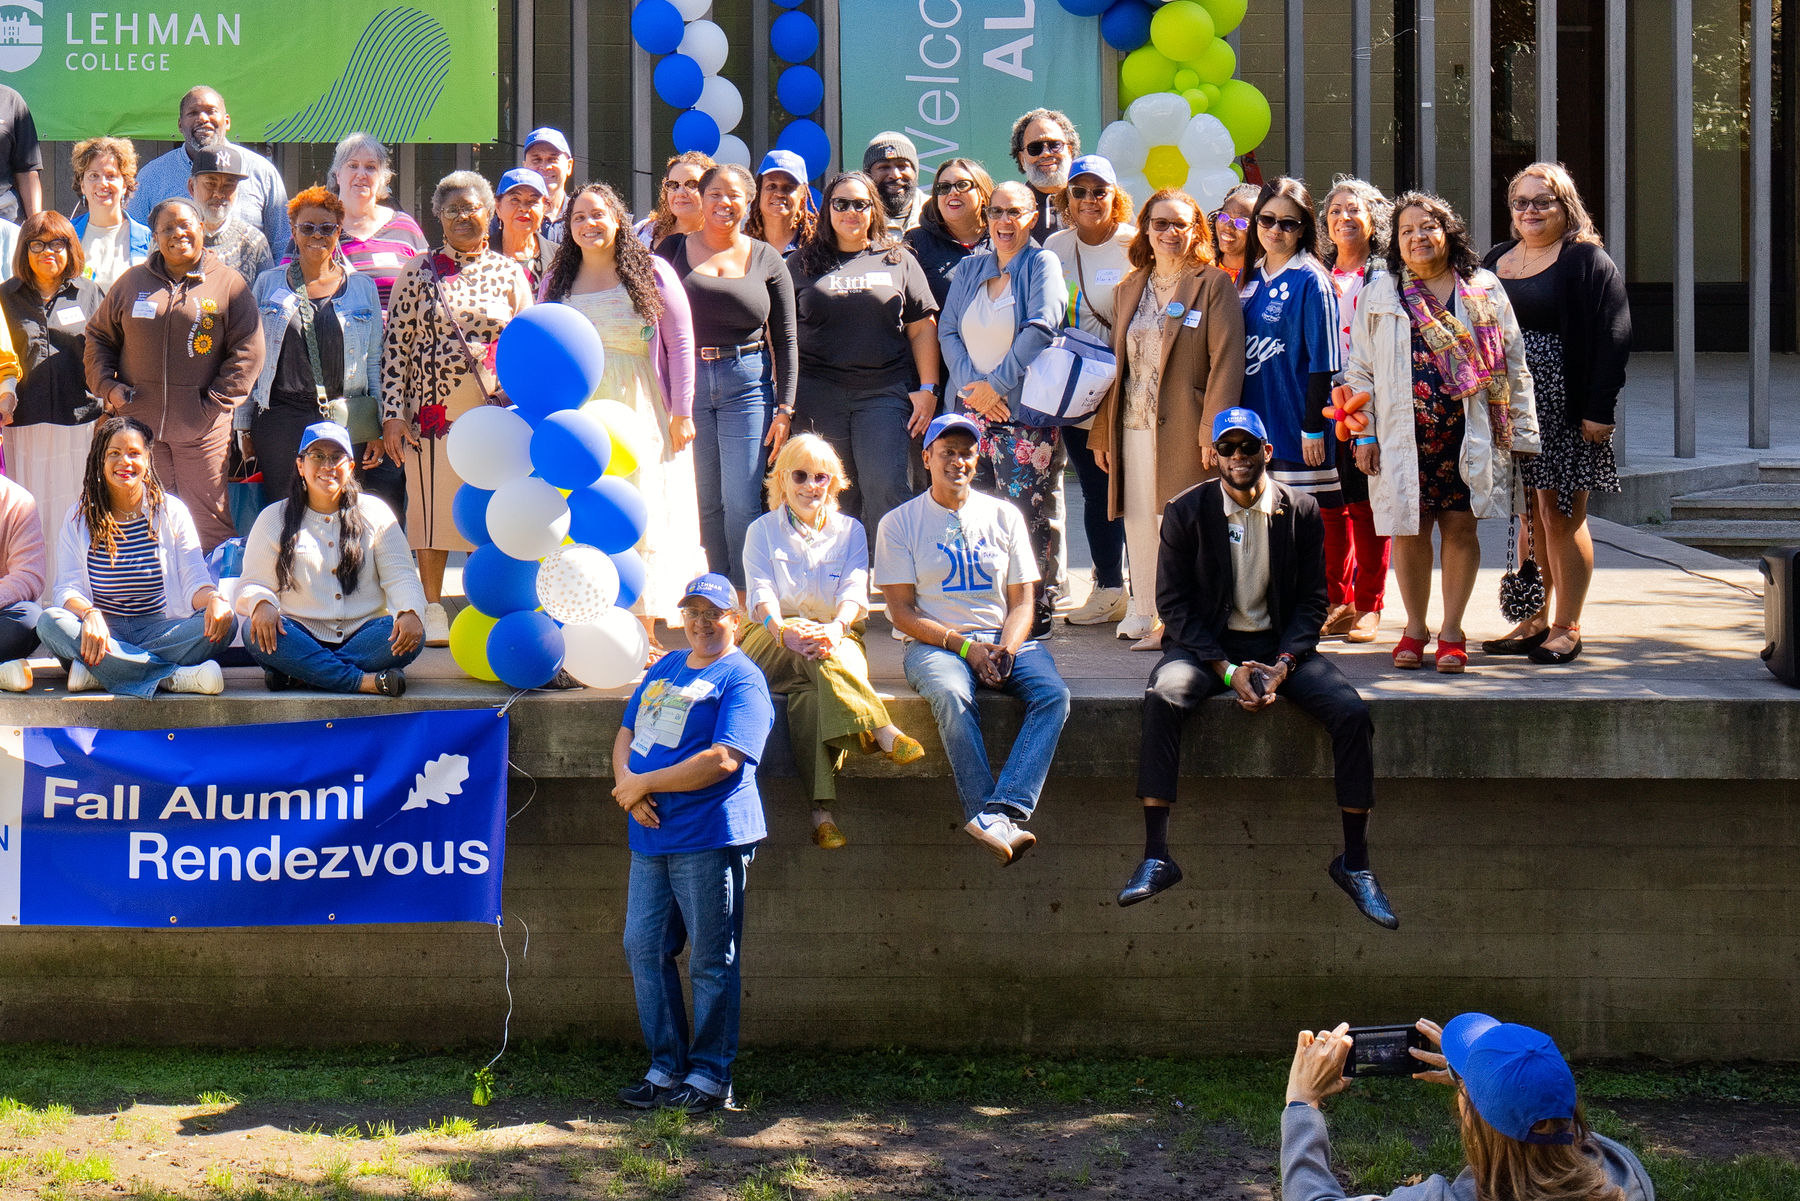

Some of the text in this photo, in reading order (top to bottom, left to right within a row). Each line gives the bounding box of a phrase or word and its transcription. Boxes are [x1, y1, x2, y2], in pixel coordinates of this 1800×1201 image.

[66, 12, 241, 46] LEHMAN
[65, 53, 170, 71] COLLEGE
[43, 773, 365, 820] Fall Alumni
[128, 831, 490, 882] Rendezvous
